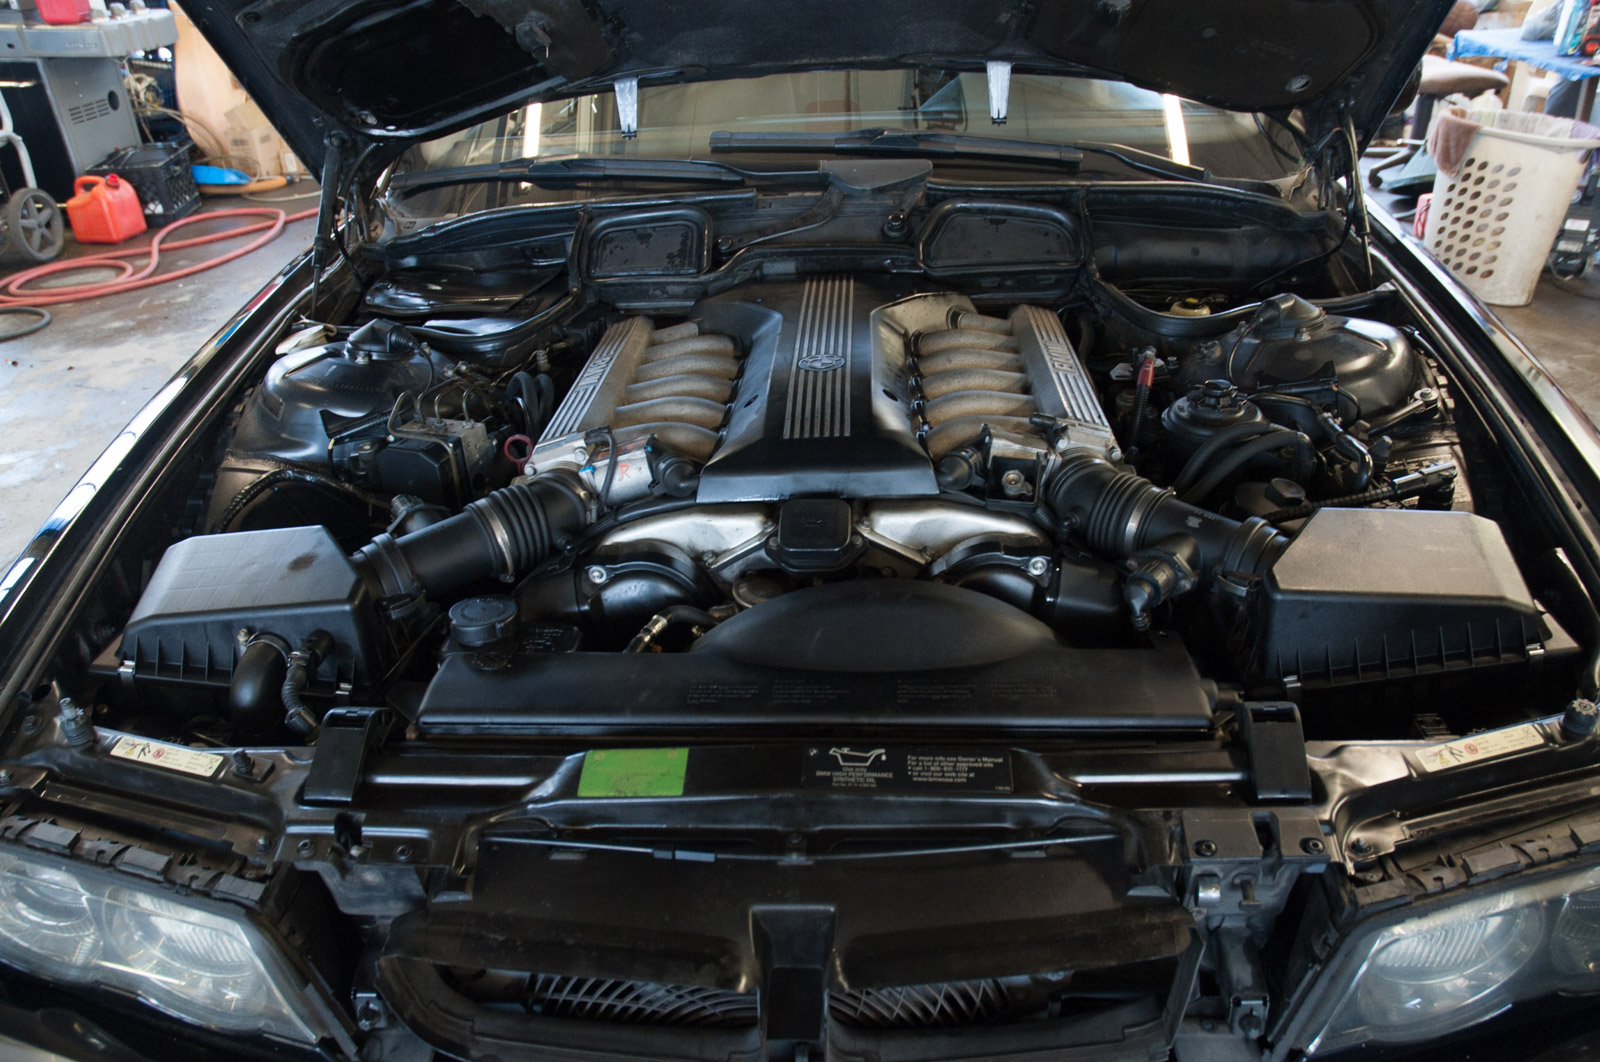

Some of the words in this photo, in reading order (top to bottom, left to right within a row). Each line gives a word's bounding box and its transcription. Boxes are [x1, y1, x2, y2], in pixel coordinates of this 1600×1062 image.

[577, 355, 613, 387] BMW
[1044, 342, 1077, 374] BMW
[619, 463, 631, 481] R
